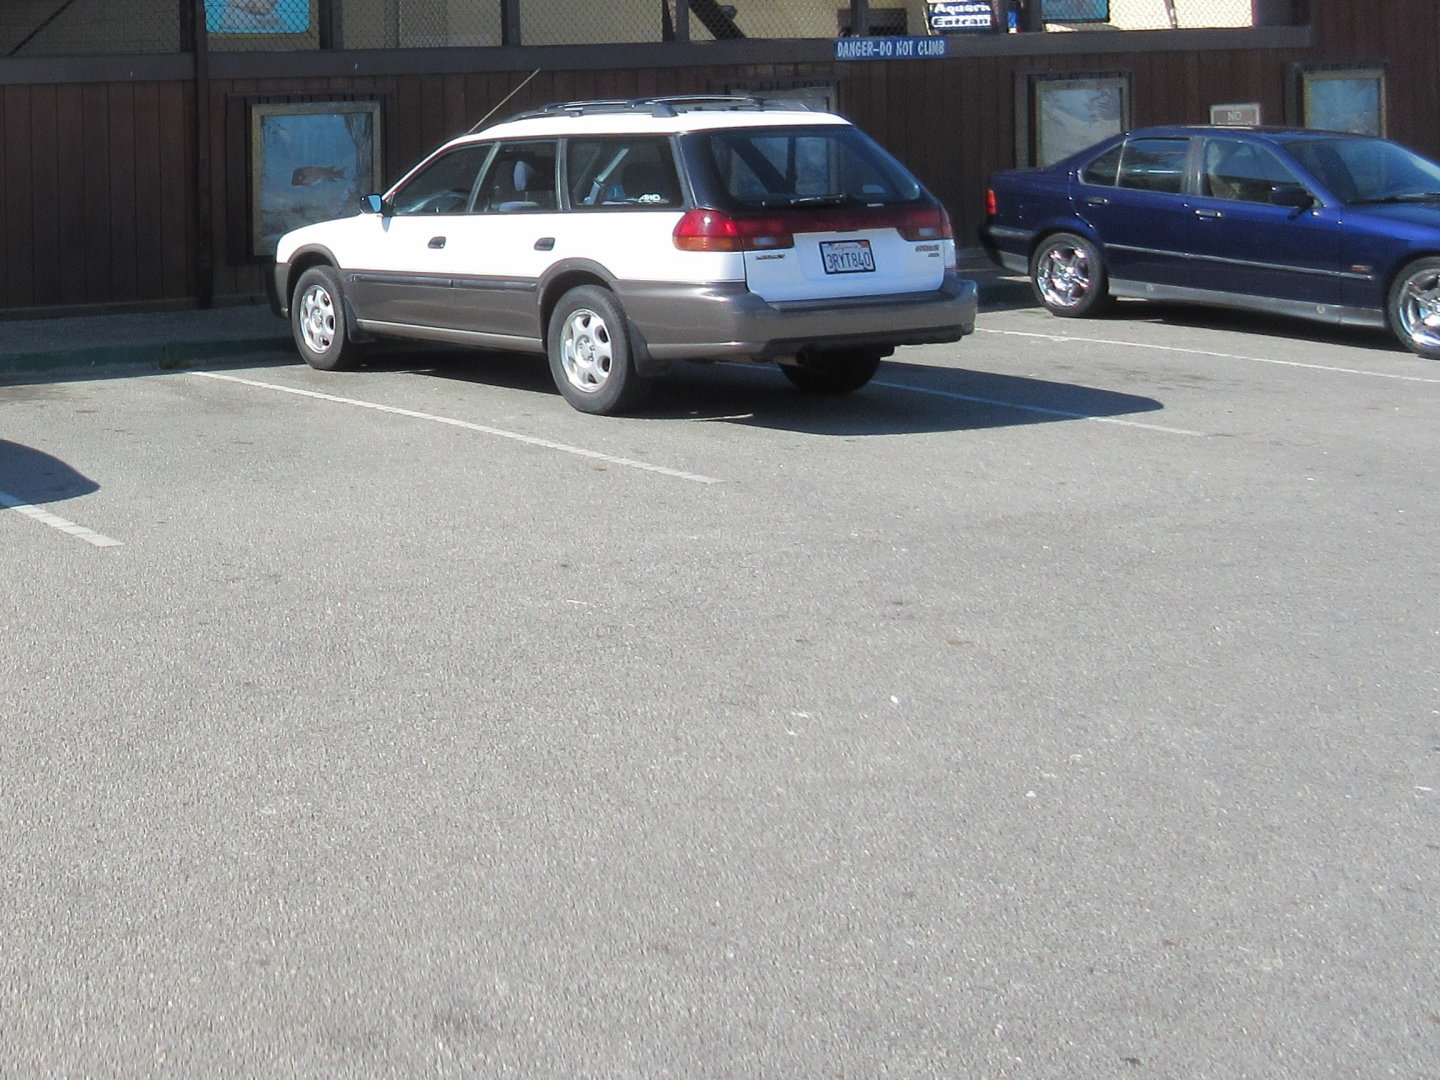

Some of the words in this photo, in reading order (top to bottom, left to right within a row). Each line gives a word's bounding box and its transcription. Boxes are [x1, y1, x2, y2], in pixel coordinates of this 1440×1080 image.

[896, 40, 914, 57] NOT
[917, 39, 945, 56] CLIMB
[1227, 111, 1242, 121] NO
[826, 251, 871, 269] 3RYT840
